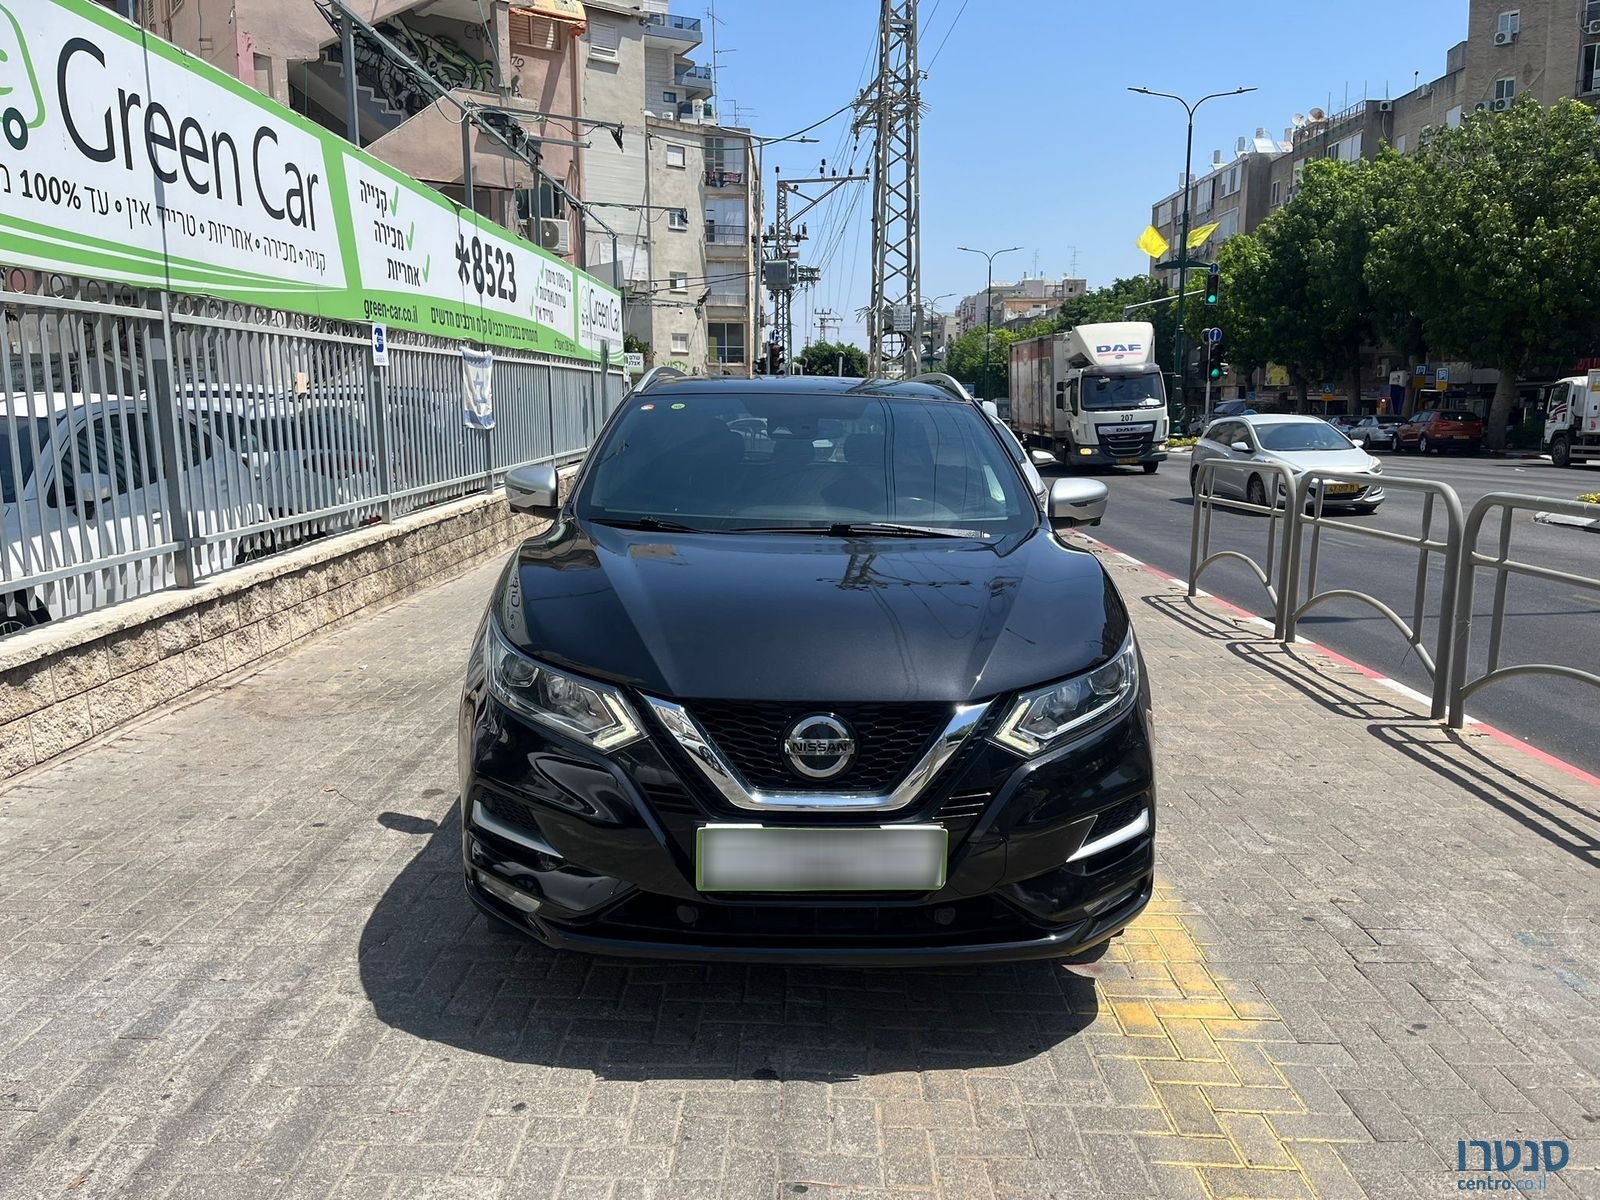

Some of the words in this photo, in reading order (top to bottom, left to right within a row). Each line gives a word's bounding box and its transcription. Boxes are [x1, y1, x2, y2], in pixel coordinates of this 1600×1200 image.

[57, 37, 243, 207] Green
[252, 126, 319, 231] Car
[20, 169, 82, 210] 100%
[84, 186, 109, 215] עד
[360, 179, 388, 219] קנייה
[126, 197, 152, 230] אין
[156, 205, 196, 237] טרייד
[208, 219, 254, 252] אחריות
[263, 236, 297, 264] מכירה
[374, 220, 405, 251] מכירה
[305, 248, 326, 277] קניה
[387, 257, 421, 287] אחריות
[364, 299, 418, 323] green-car.co.il
[431, 307, 455, 327] חדשים
[589, 289, 609, 329] Green
[610, 298, 620, 332] Car
[1096, 344, 1142, 353] DAF
[1121, 414, 1134, 422] 207
[793, 742, 848, 752] NISSAN
